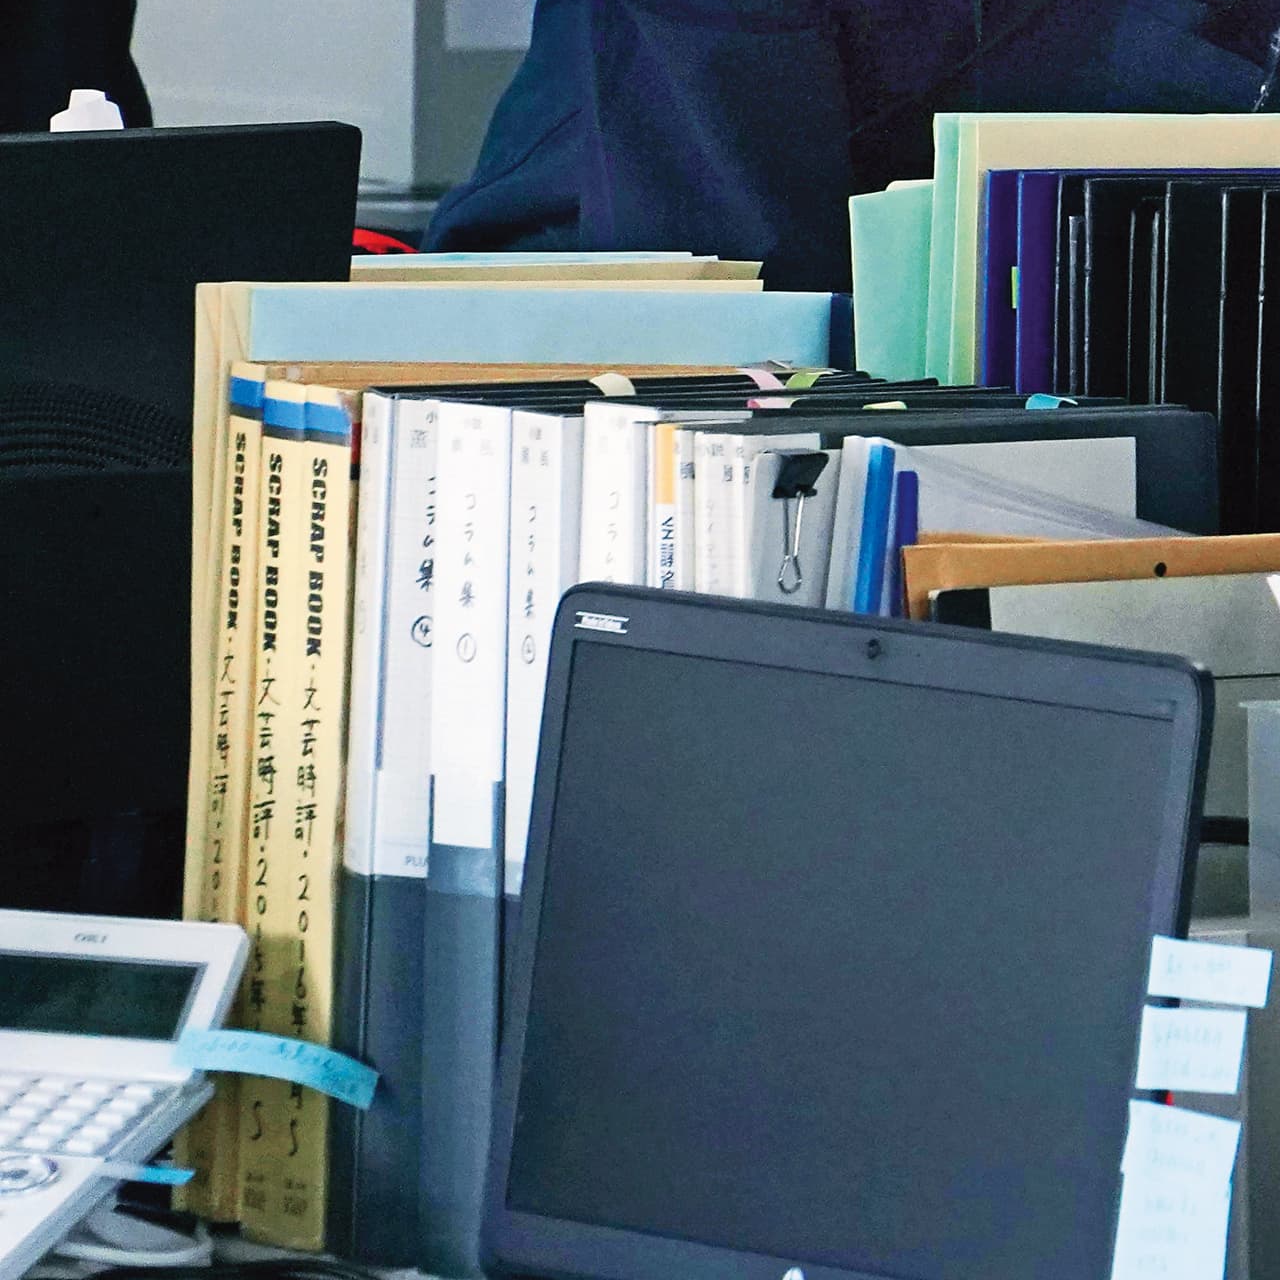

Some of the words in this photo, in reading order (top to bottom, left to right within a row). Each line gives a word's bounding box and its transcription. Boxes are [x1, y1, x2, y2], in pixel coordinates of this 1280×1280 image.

[229, 431, 247, 538] SCRAP
[263, 453, 284, 559] SCRAP
[309, 456, 330, 565] SCRAP
[226, 544, 243, 631] BOOK
[261, 566, 280, 652] BOOK
[305, 570, 325, 658] BOOK
